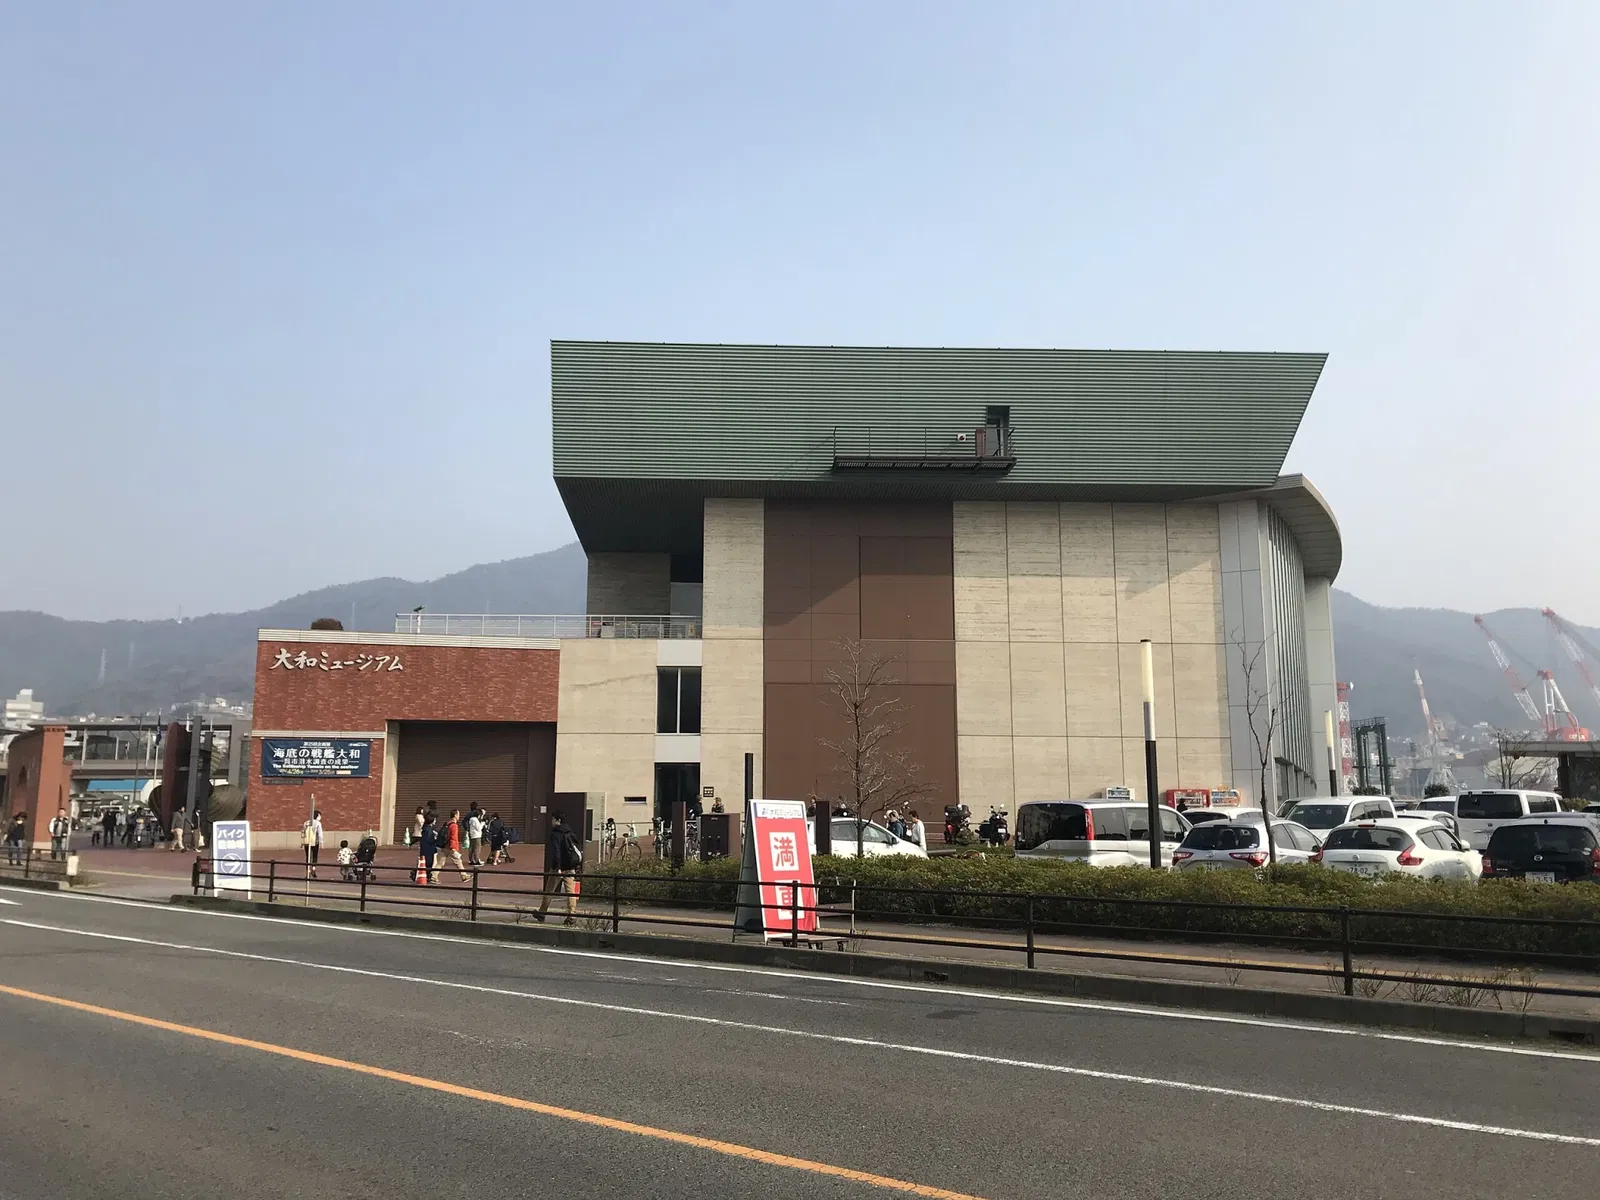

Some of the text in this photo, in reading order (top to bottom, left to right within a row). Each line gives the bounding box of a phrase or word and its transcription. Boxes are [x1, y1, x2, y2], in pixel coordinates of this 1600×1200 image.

[269, 647, 403, 671] 大和ミュージアム
[273, 748, 361, 758] 海底の戦艦大和
[217, 828, 245, 839] バイク
